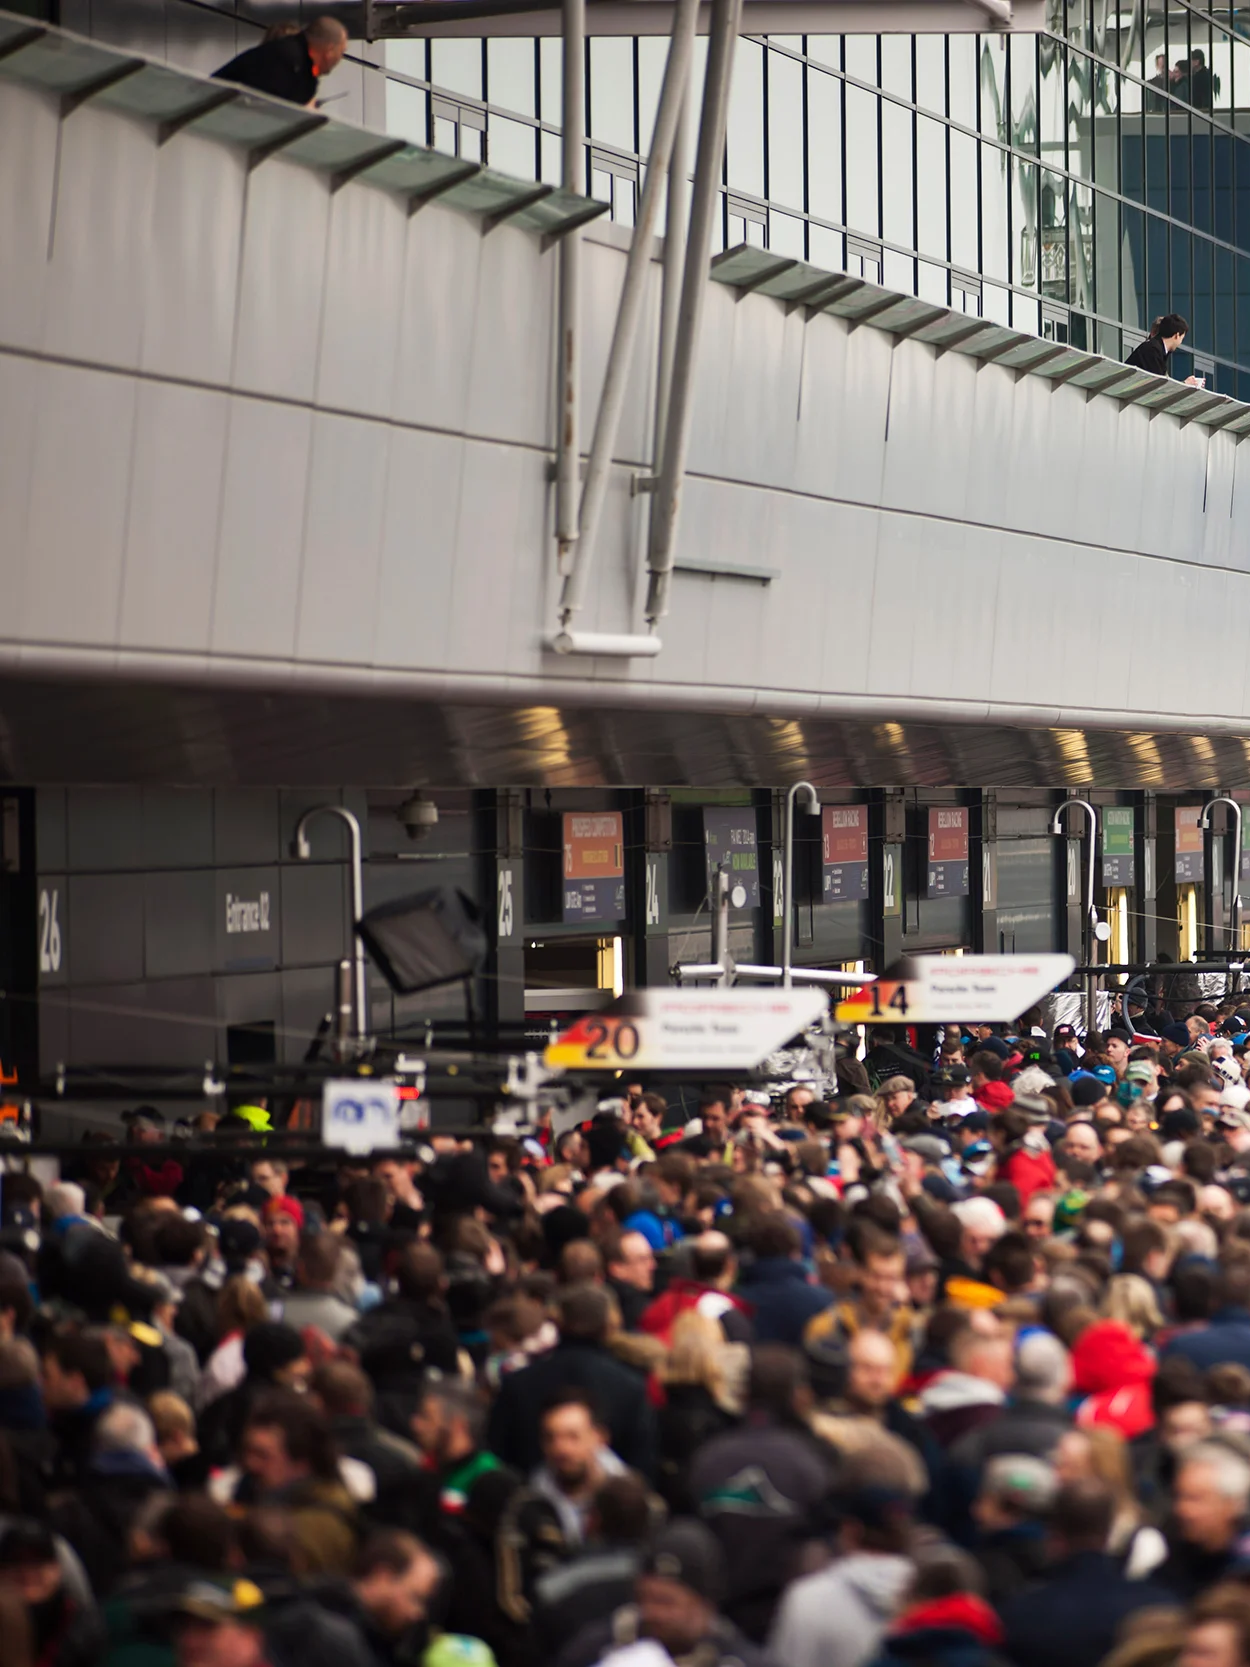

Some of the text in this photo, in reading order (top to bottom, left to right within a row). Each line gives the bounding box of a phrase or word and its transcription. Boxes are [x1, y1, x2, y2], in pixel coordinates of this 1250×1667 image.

[646, 864, 659, 925] 24
[883, 854, 895, 907] 22
[982, 852, 991, 902] 21
[1067, 848, 1076, 896] 20
[498, 870, 513, 937] 25
[39, 889, 61, 972] 26
[869, 985, 908, 1017] 14
[584, 1017, 641, 1060] 20
